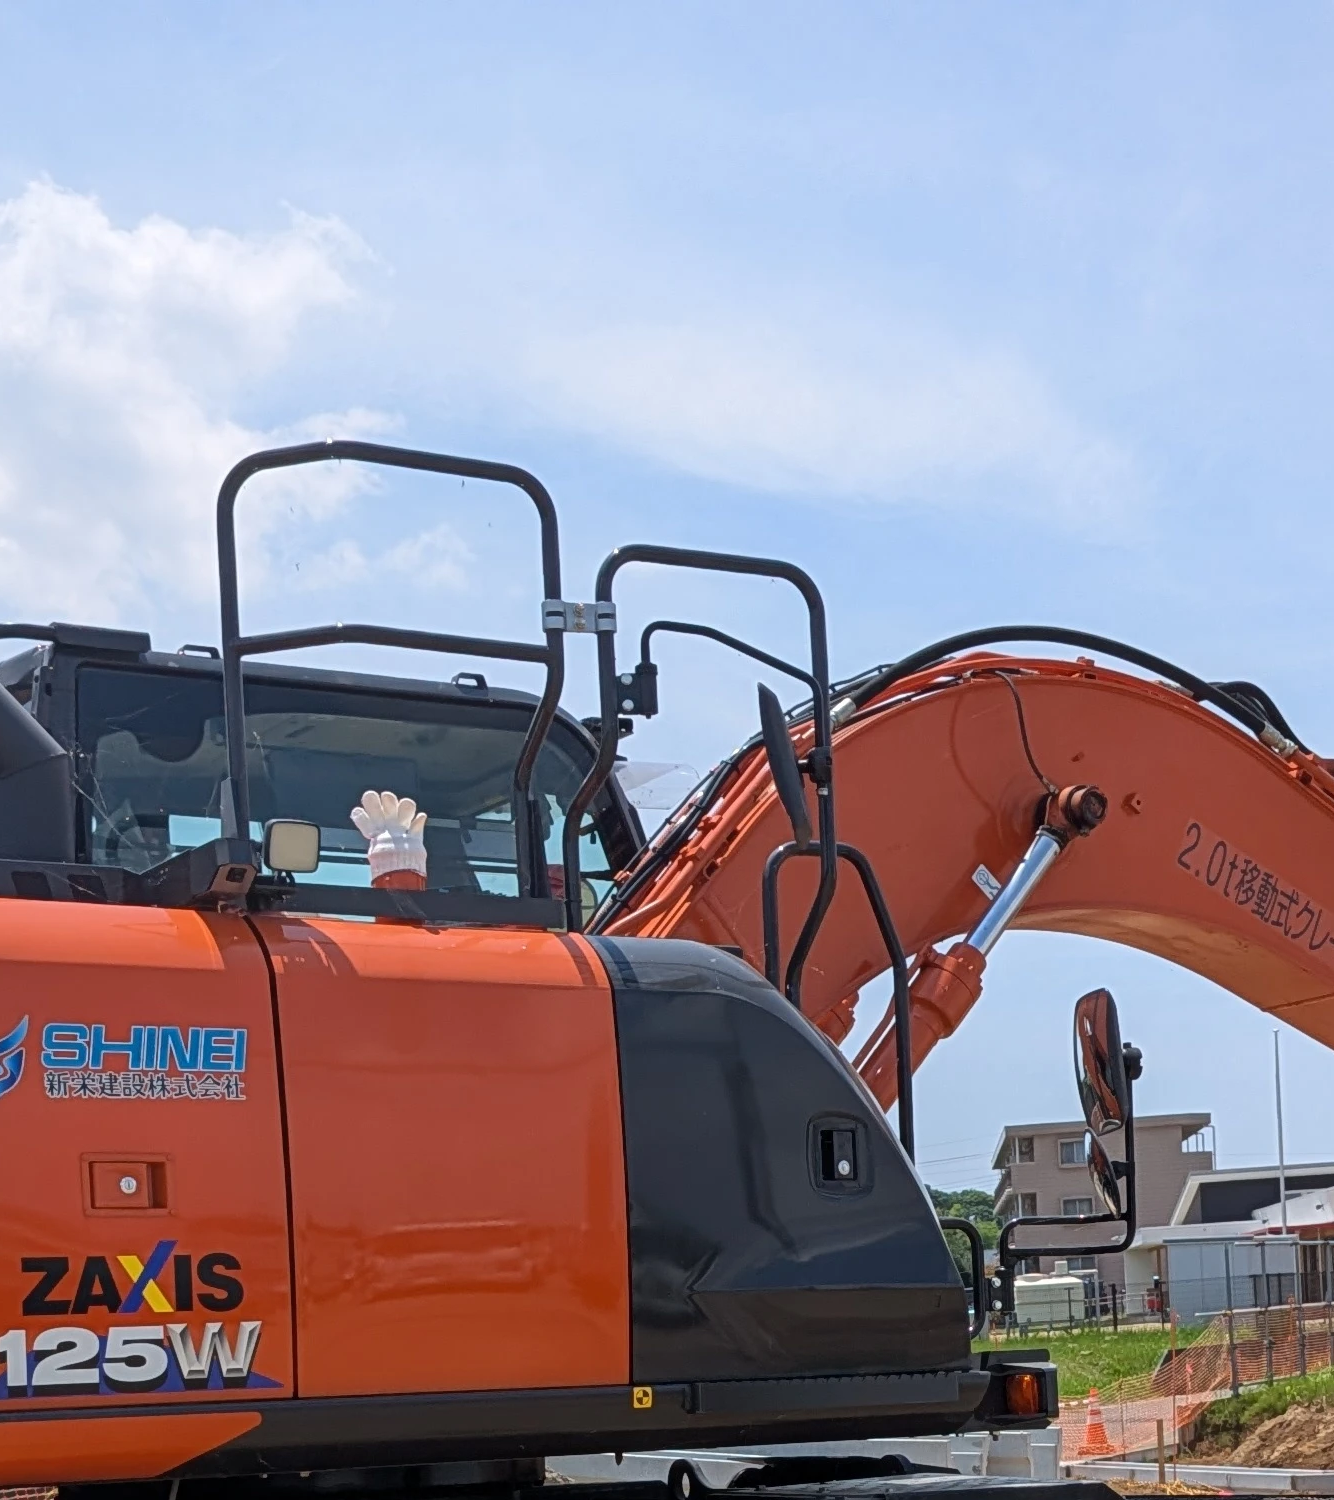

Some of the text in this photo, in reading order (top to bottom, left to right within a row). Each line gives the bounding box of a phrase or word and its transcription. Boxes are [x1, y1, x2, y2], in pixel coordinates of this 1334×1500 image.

[41, 1024, 247, 1072] SHINEI
[44, 1071, 246, 1100] 新栄建設株式会社
[21, 1240, 244, 1316] ZAXIS
